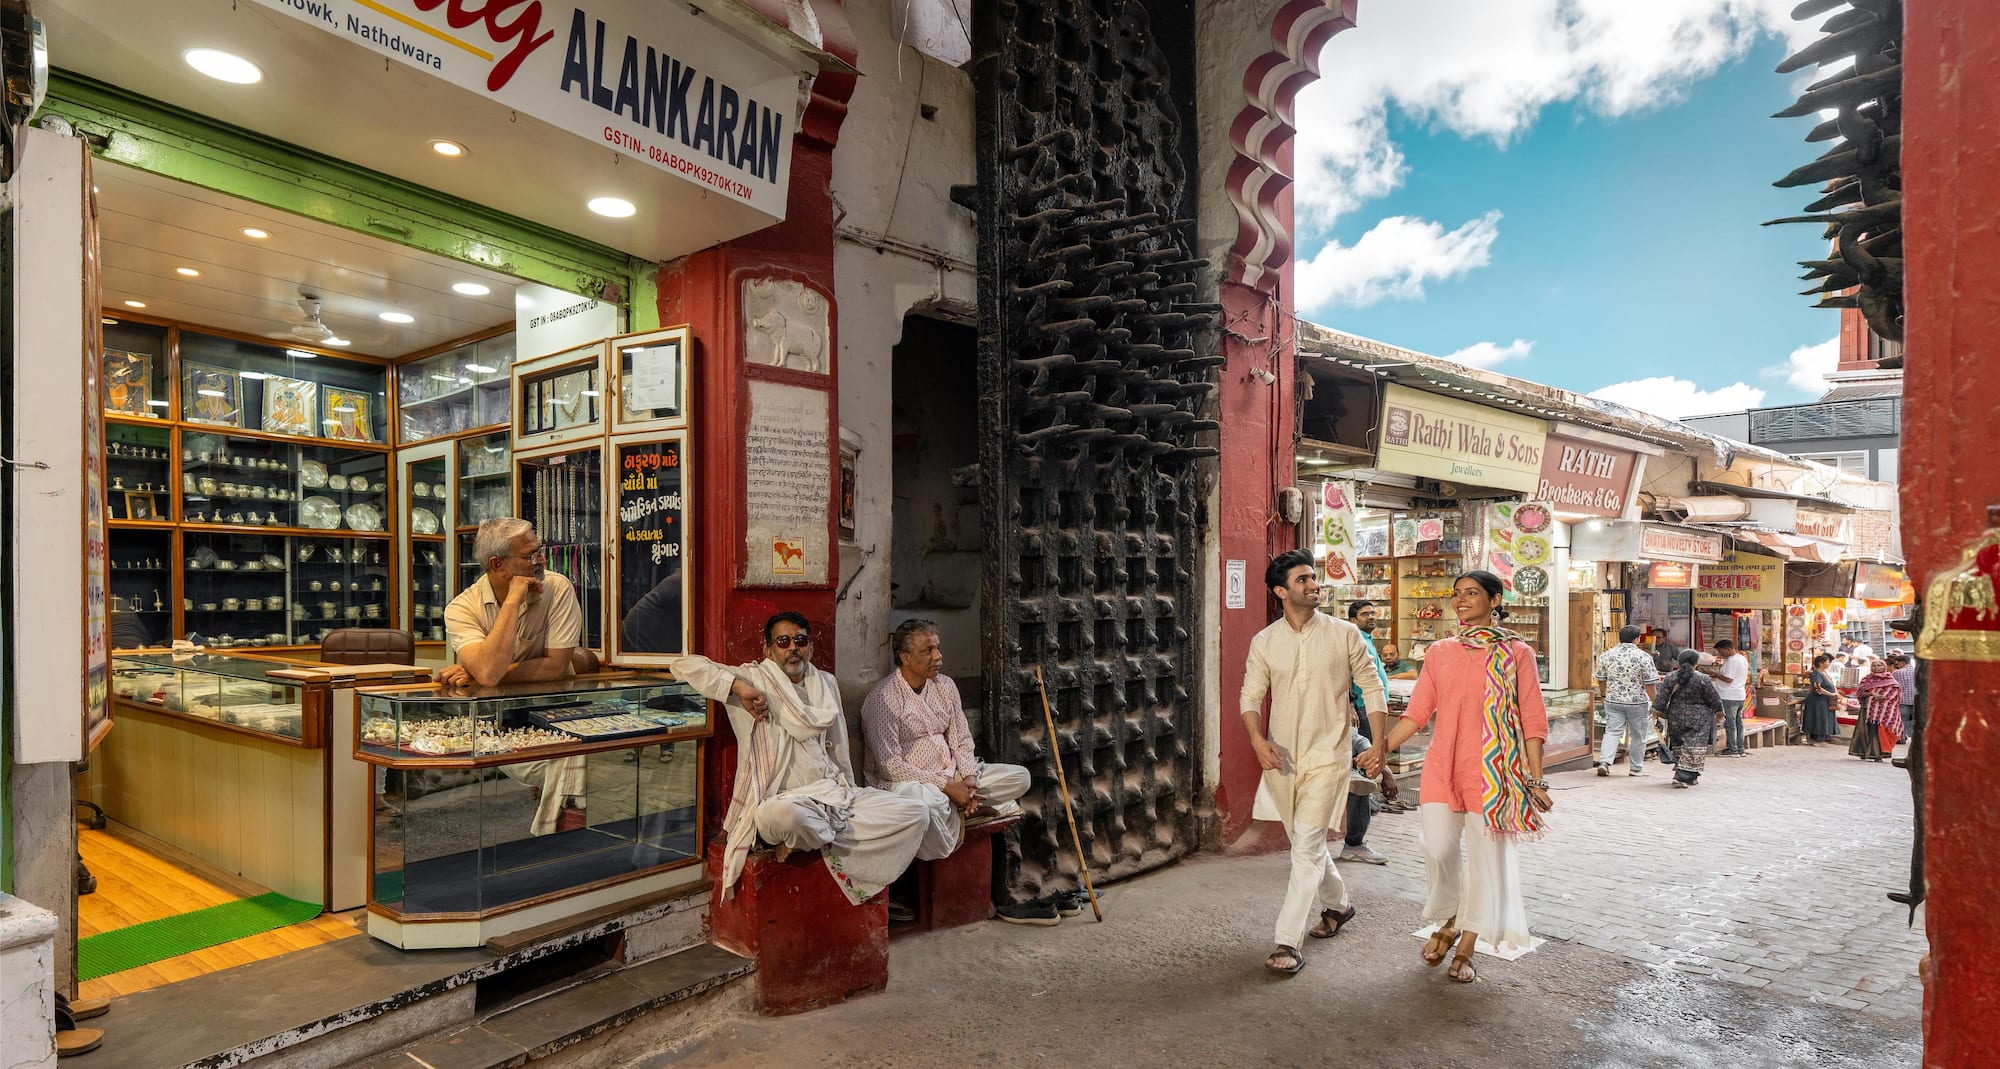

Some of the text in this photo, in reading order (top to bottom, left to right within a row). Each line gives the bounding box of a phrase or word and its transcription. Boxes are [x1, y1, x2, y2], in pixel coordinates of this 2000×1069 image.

[346, 14, 442, 70] Nathdwara
[560, 8, 782, 184] ALANKARAN
[604, 126, 752, 200] GSTIN- 08ABQPK9270K1ZW
[1386, 434, 1408, 446] RATHI
[1412, 413, 1540, 467] Rathi Wala & Sons
[1450, 462, 1483, 478] Jewellers
[1559, 445, 1617, 480] RATHI
[1537, 478, 1593, 507] Brothers
[1594, 487, 1604, 508] &
[1693, 539, 1711, 554] STORE
[1698, 574, 1761, 591] प्रसाद
